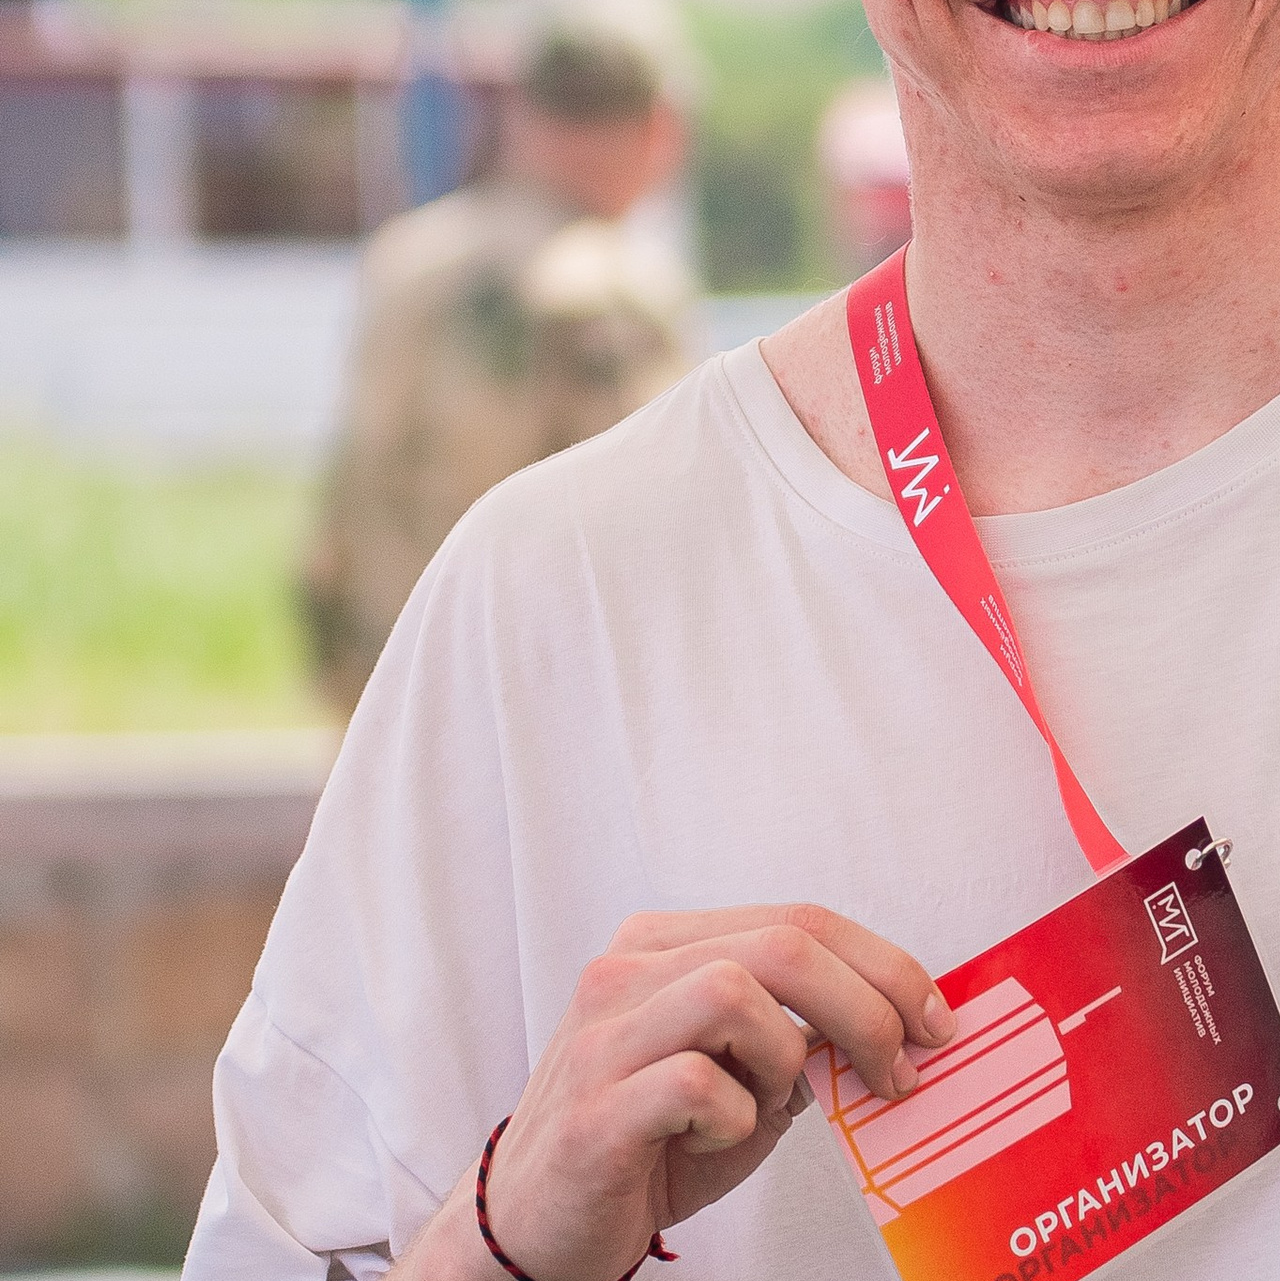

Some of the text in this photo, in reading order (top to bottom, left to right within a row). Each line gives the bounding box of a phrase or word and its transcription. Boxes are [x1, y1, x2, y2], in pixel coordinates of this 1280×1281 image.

[869, 346, 884, 385] форум
[885, 301, 902, 366] инициатив
[1173, 966, 1207, 1038] ИНИЦИАТИВ
[1183, 960, 1222, 1046] МОЛОДЕЖНЫХ
[1194, 954, 1216, 998] ФОРУМ
[1009, 1082, 1255, 1257] ОРГАНИЗАТОР
